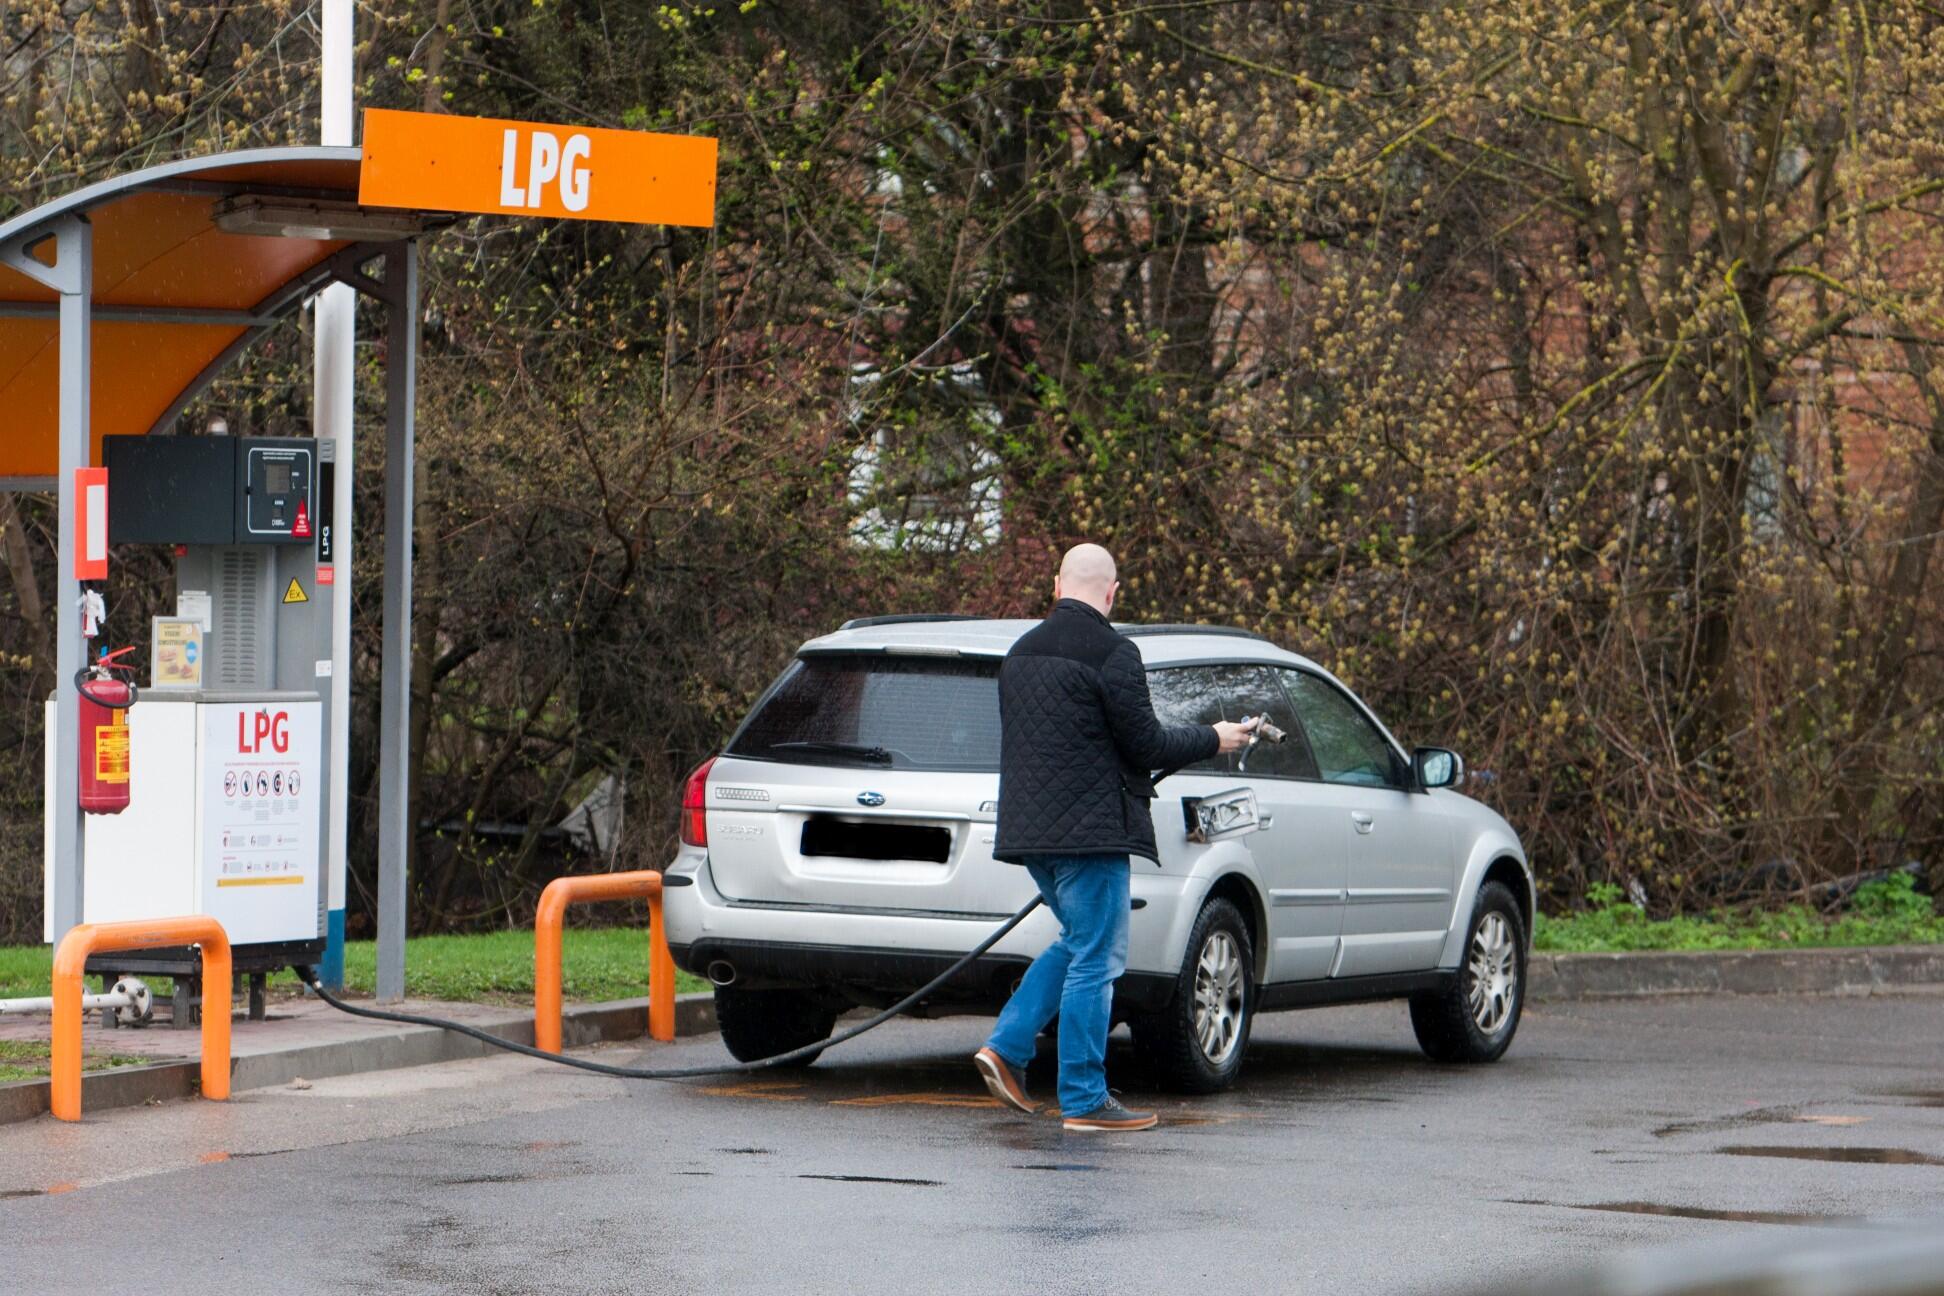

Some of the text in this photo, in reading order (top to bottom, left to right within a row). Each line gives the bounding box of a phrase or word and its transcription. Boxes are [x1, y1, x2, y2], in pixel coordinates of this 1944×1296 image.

[500, 129, 591, 212] LPG
[322, 526, 330, 556] LPG
[238, 711, 289, 753] LPG
